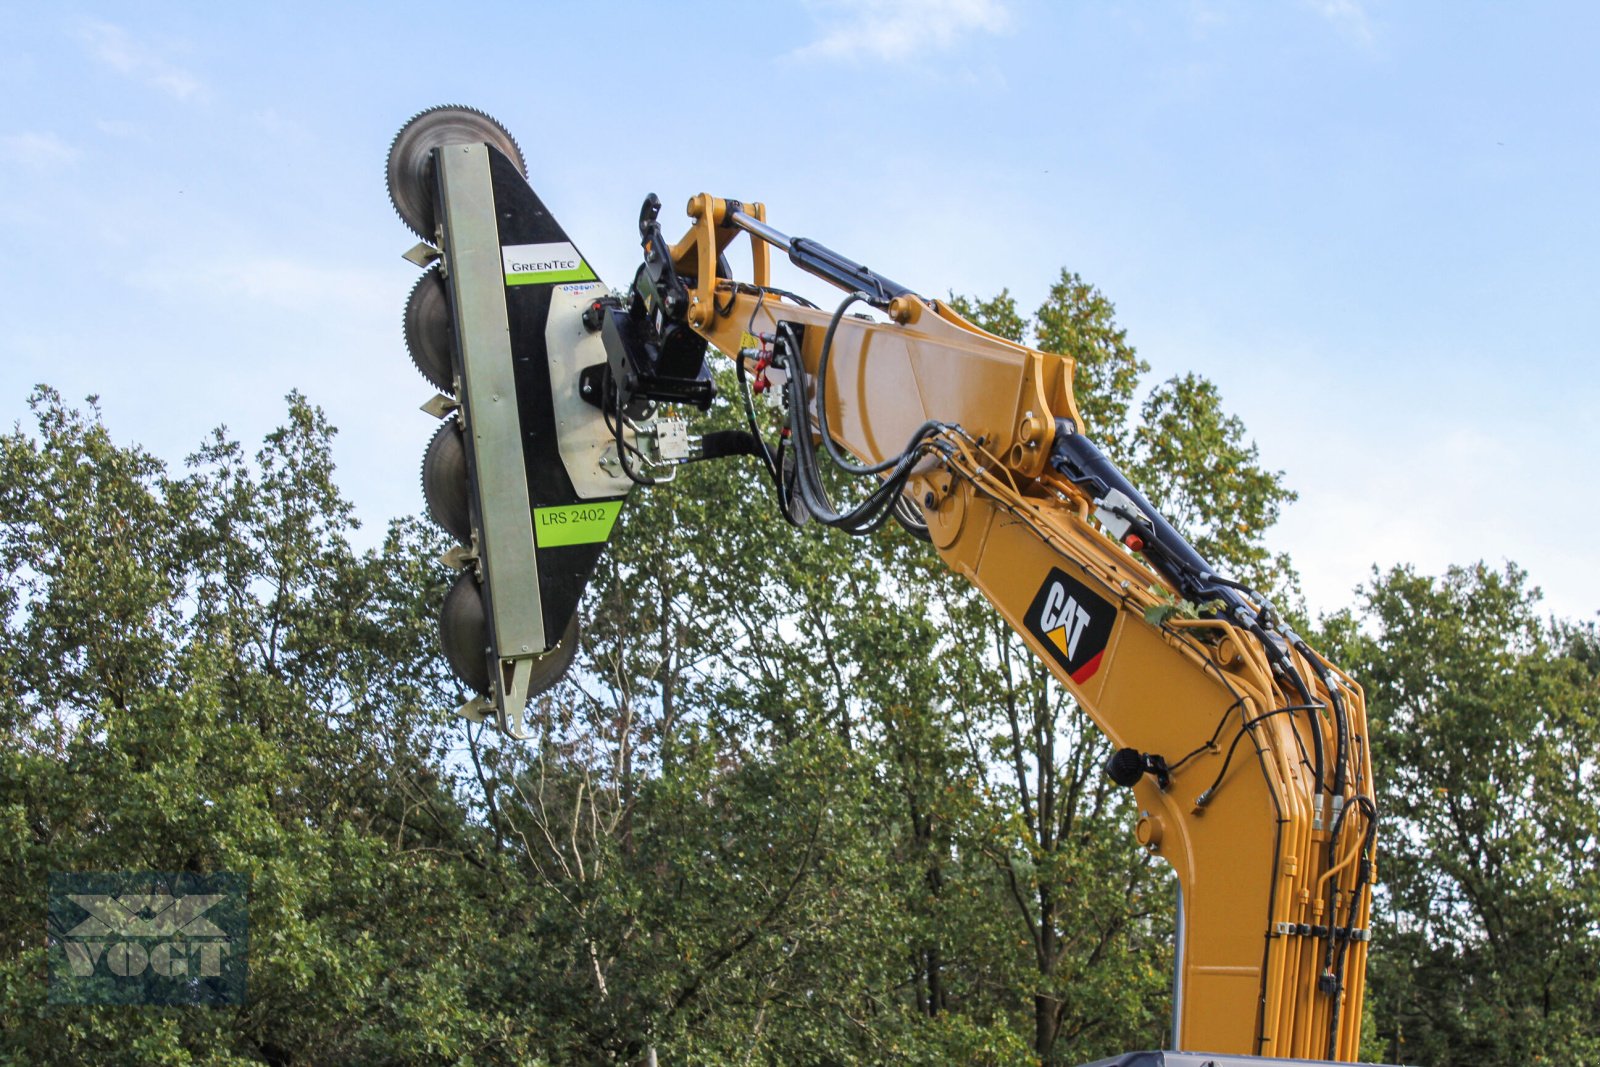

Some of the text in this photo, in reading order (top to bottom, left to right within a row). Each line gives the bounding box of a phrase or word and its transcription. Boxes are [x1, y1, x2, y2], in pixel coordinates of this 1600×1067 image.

[542, 508, 605, 525] LRS 2402
[1040, 581, 1091, 662] CAT
